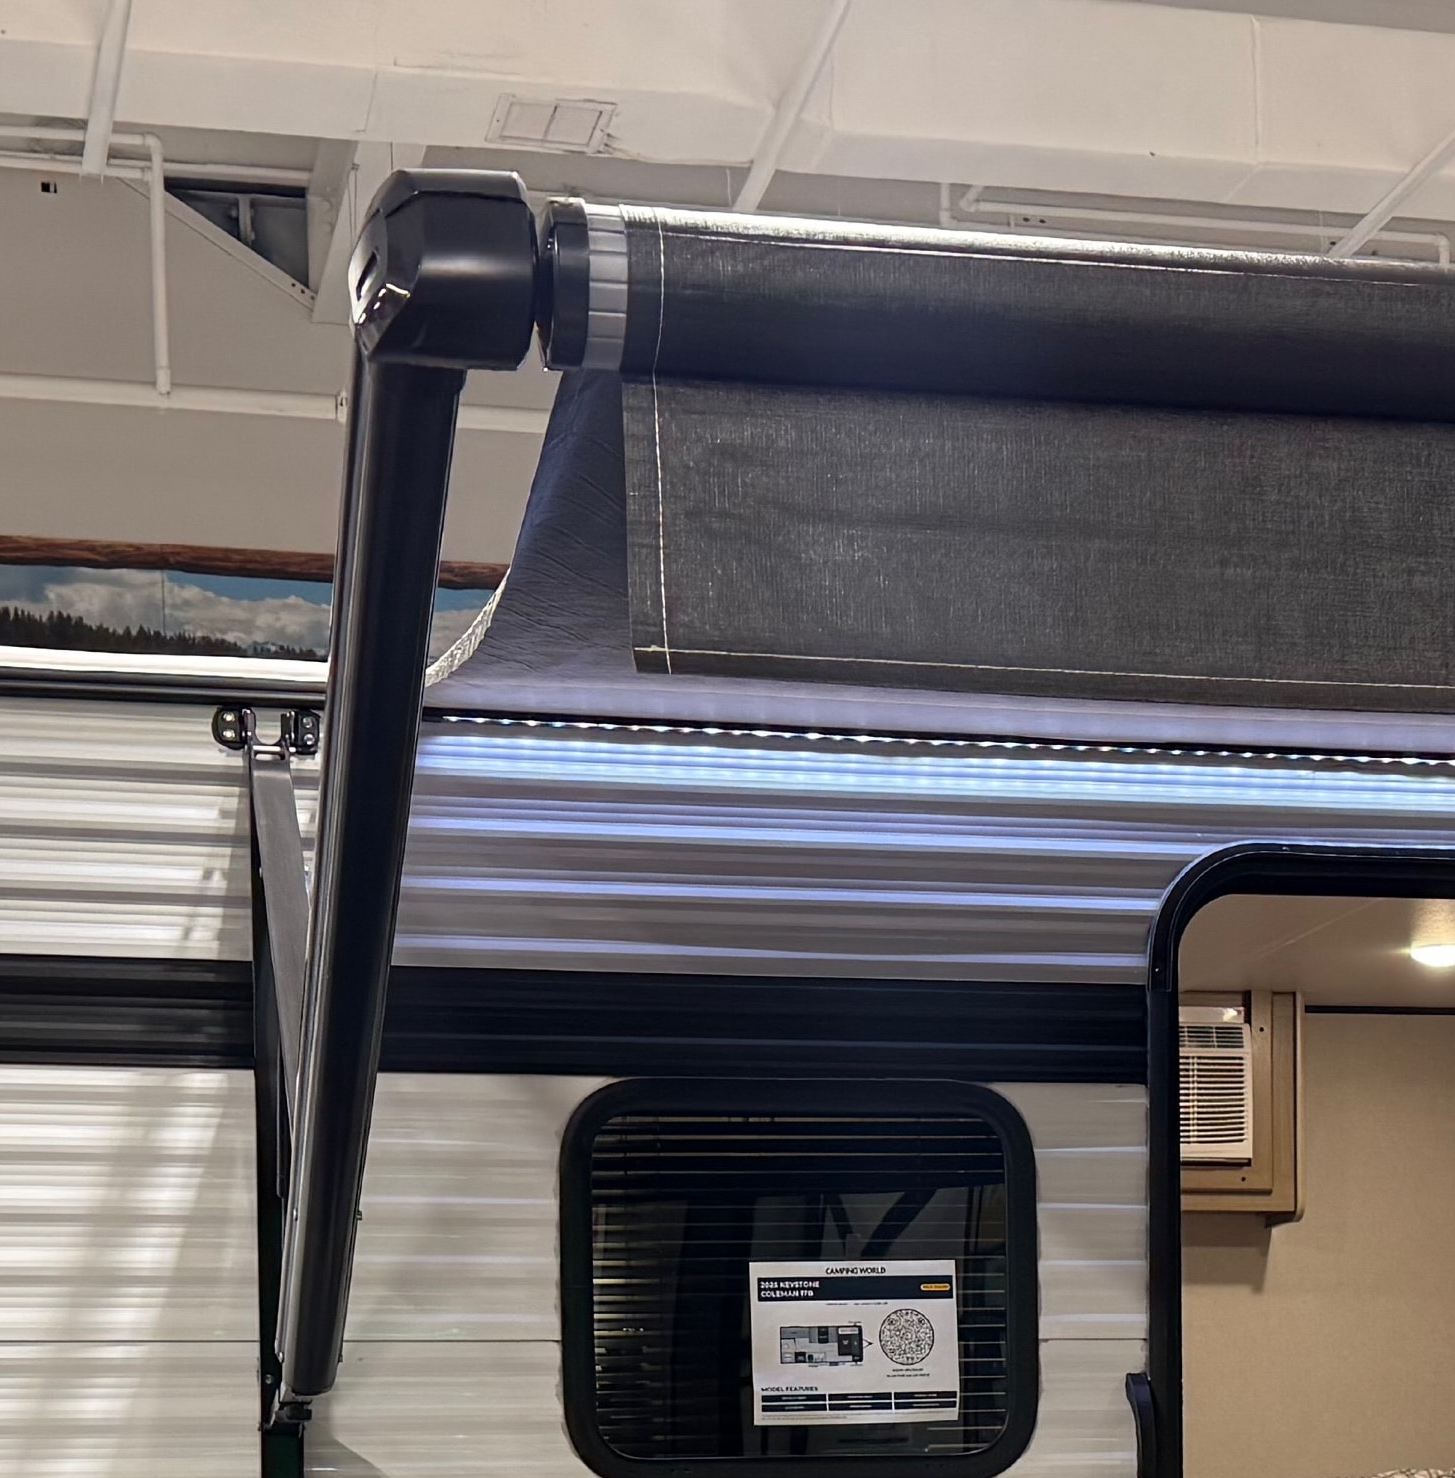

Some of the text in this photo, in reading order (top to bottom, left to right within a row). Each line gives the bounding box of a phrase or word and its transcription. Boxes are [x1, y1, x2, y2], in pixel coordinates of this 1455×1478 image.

[825, 1266, 887, 1276] CAMPING WORLD
[760, 1290, 799, 1298] COLEMAN
